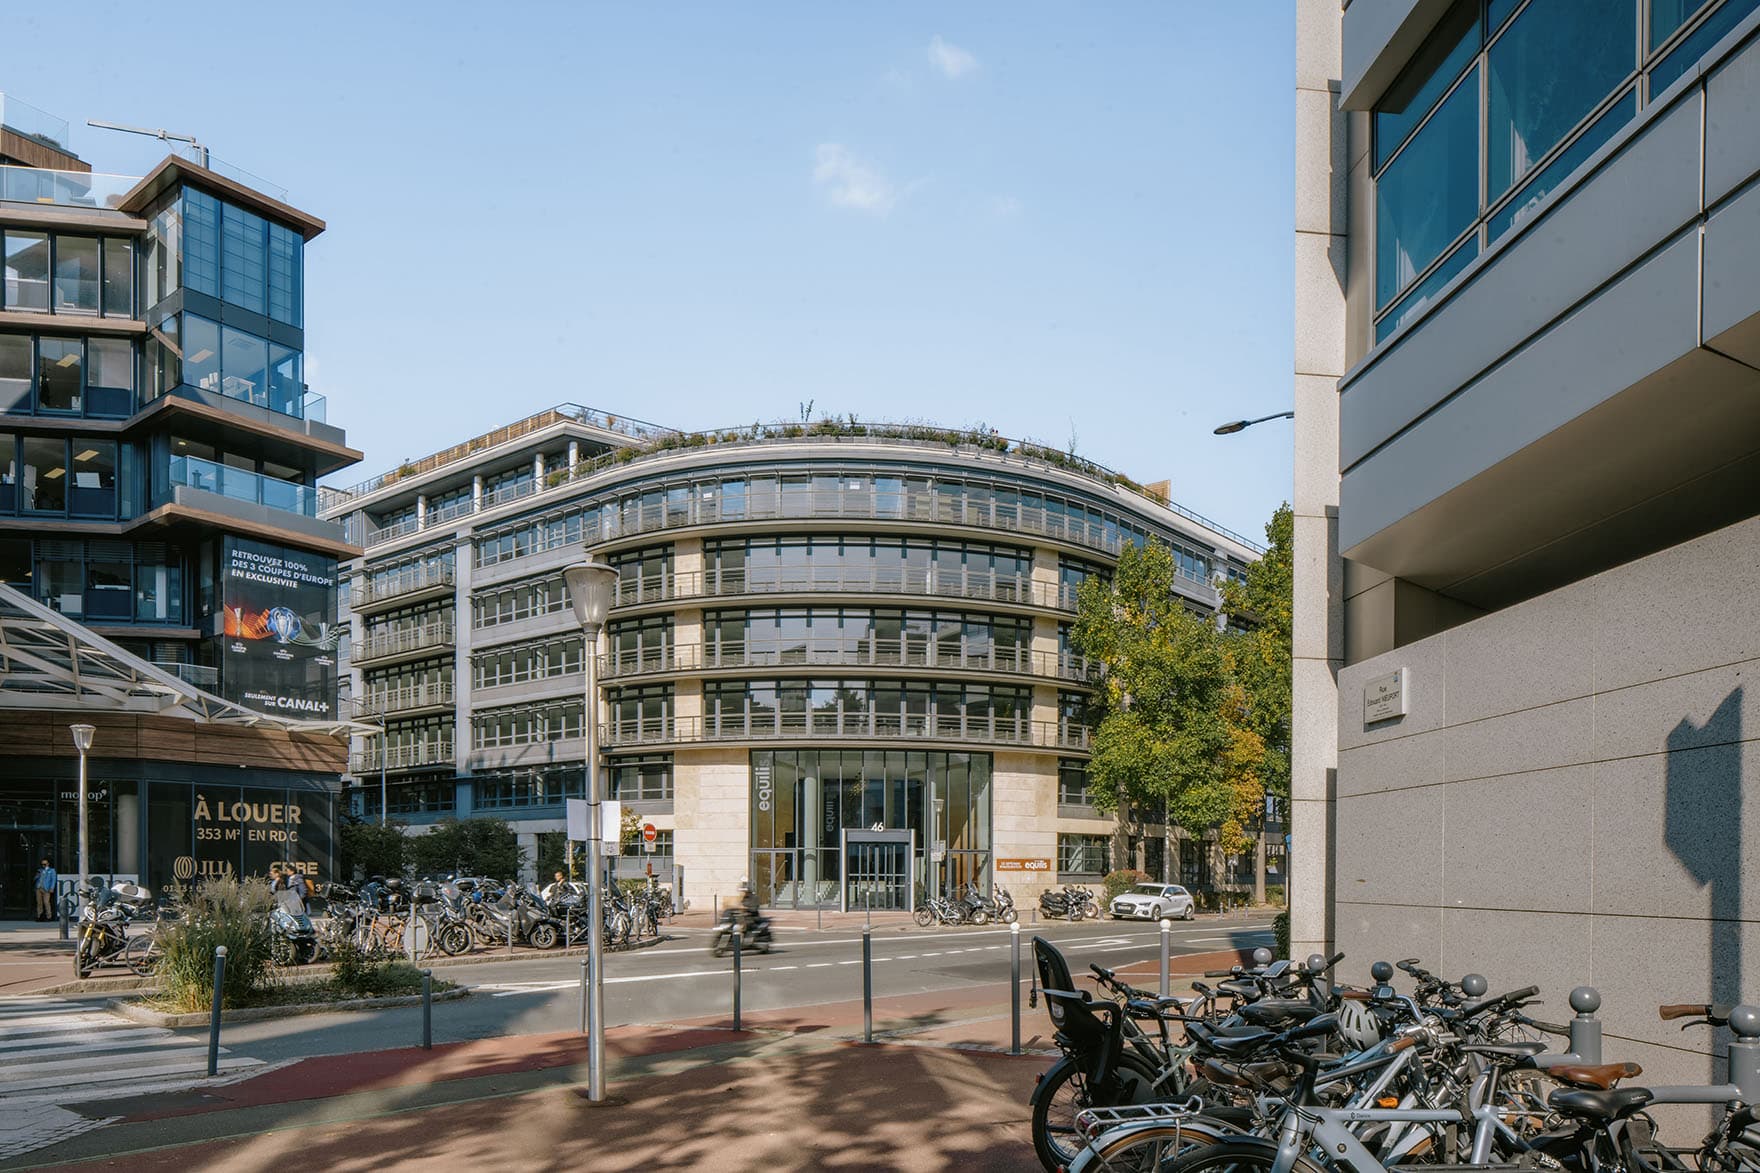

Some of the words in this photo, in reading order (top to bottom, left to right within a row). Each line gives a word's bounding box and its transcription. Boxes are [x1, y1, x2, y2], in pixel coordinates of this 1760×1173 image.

[232, 550, 282, 566] RETROUVEZ
[284, 560, 308, 572] 100%
[231, 559, 249, 569] DES
[249, 563, 256, 571] 3
[257, 564, 292, 578] COUPES
[293, 571, 334, 587] D'EUROPE
[231, 568, 244, 578] EN
[277, 696, 330, 713] CANAL+
[60, 788, 108, 802] moop'
[194, 793, 212, 821] À
[217, 801, 302, 825] LOUER
[870, 821, 884, 832] 46
[196, 827, 222, 841] 353
[248, 829, 266, 841] EN
[269, 830, 299, 842] RDC
[198, 860, 227, 875] JLL
